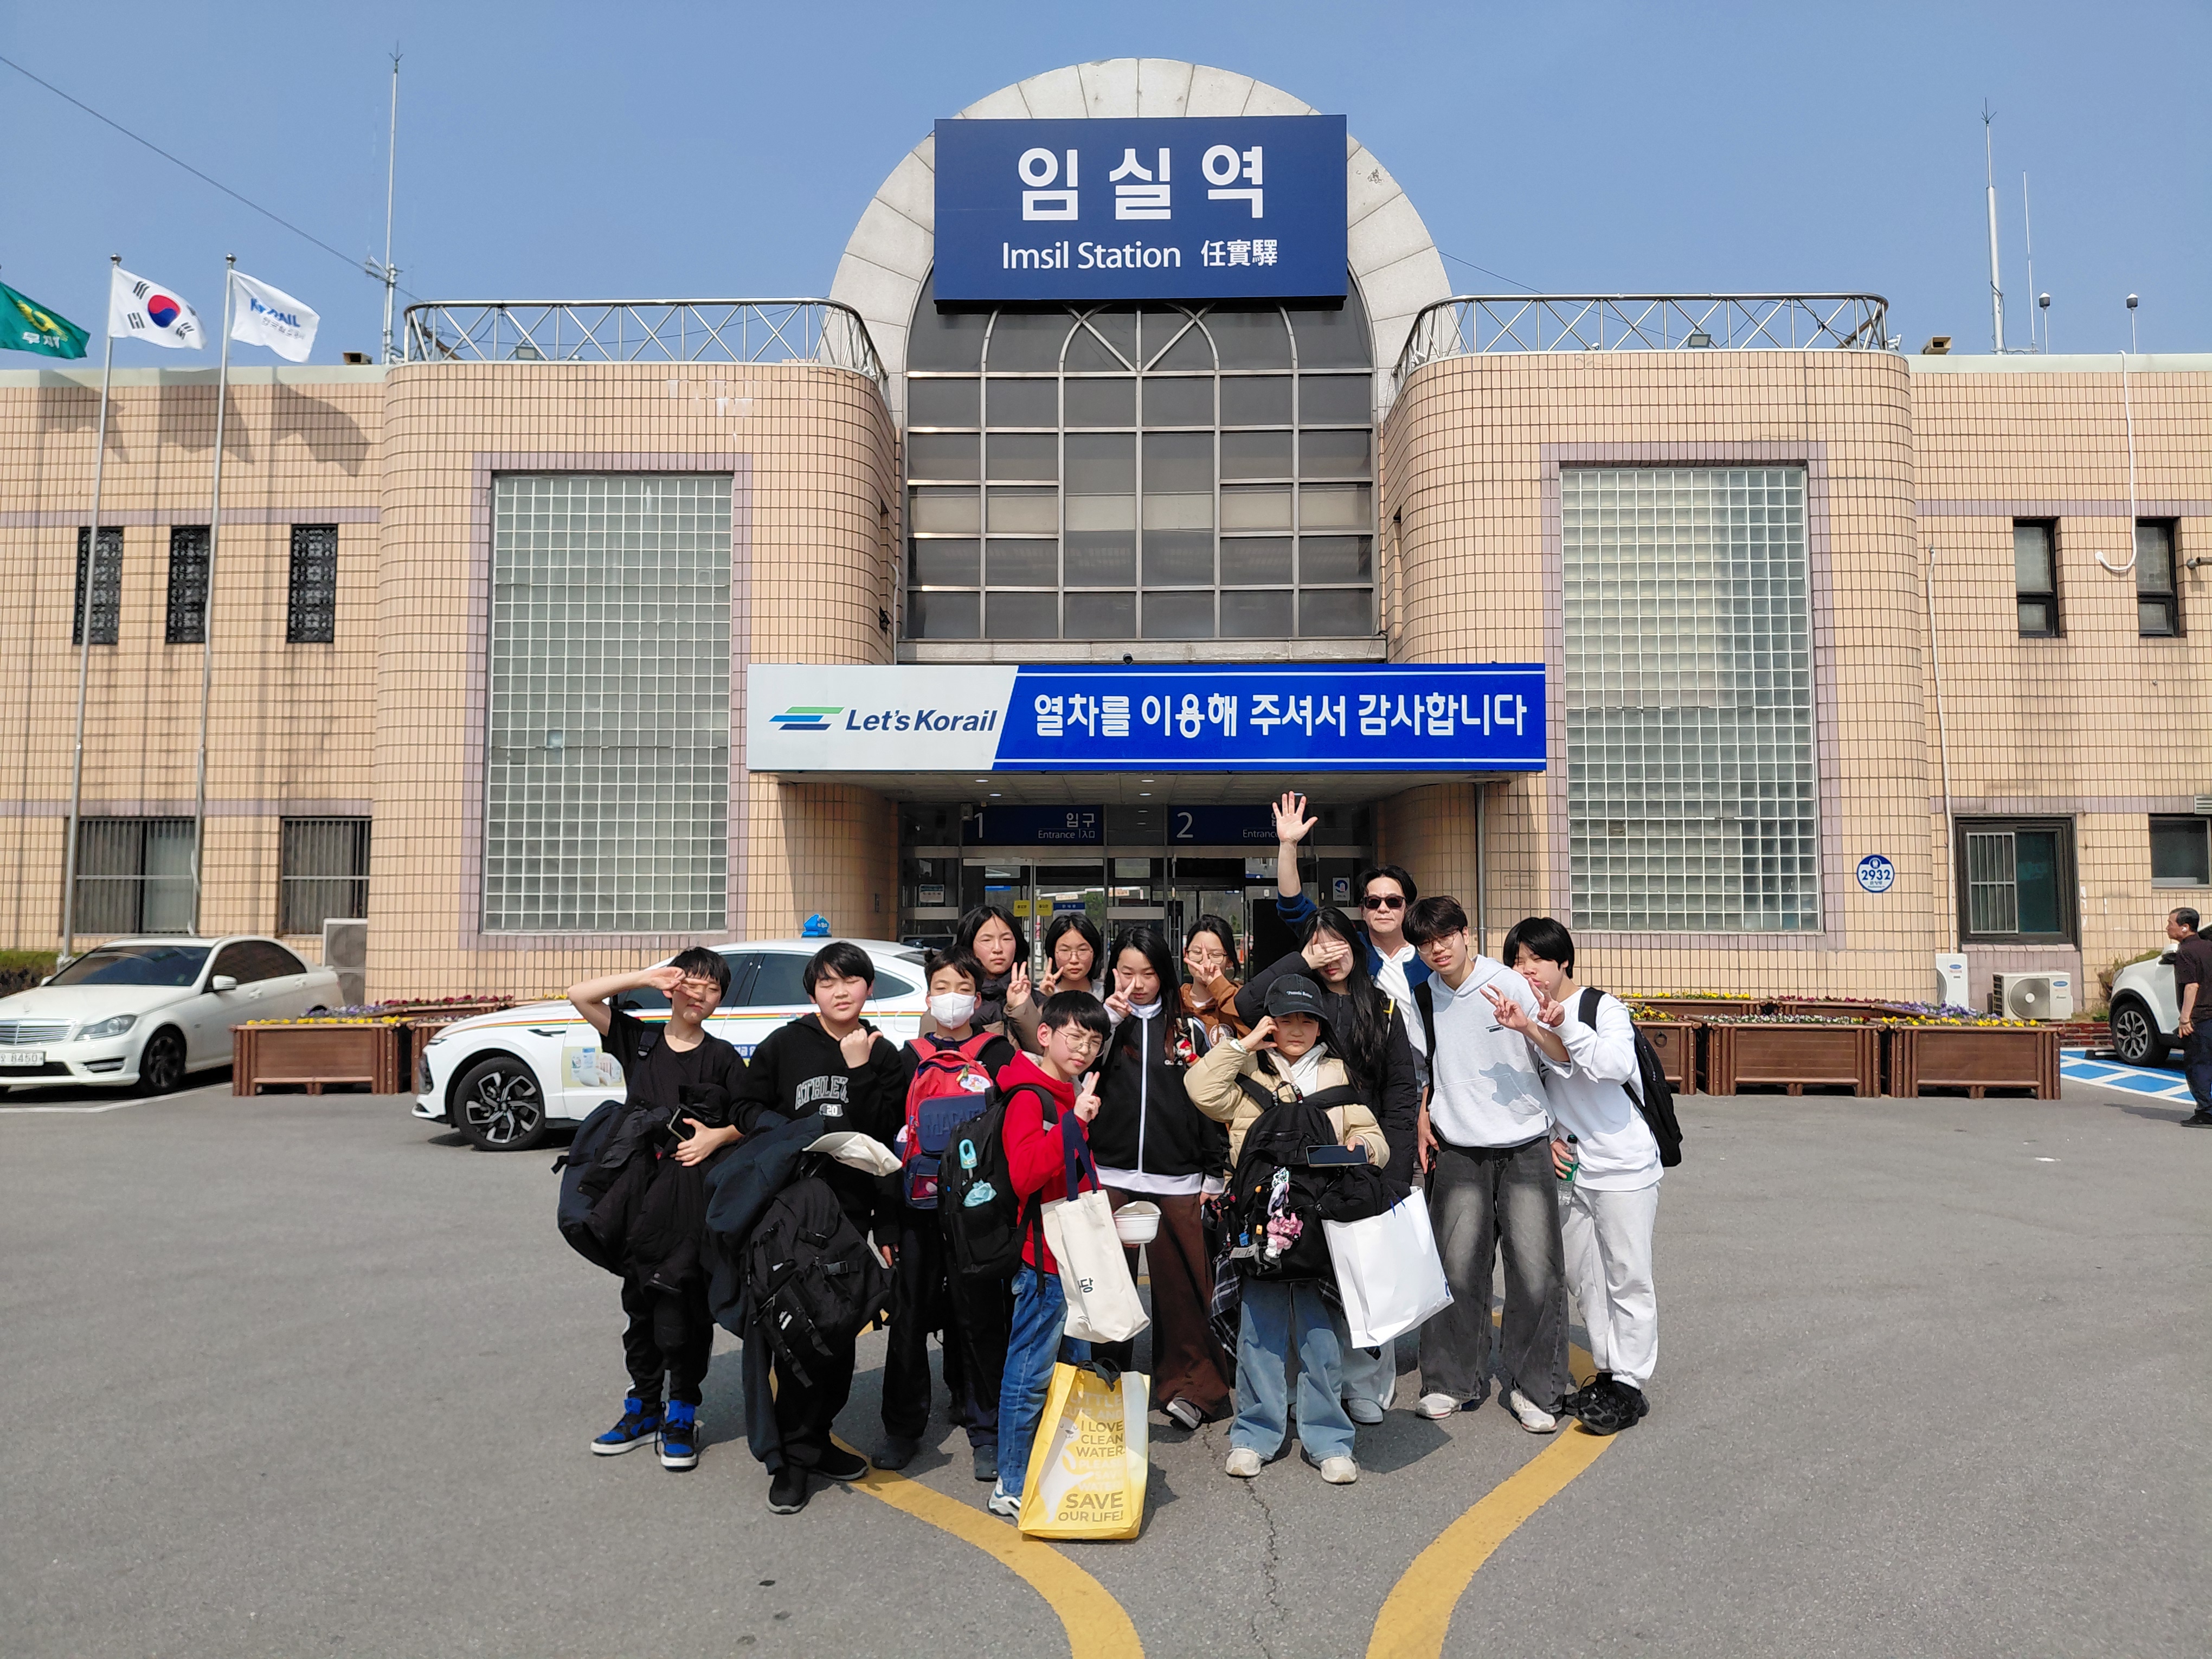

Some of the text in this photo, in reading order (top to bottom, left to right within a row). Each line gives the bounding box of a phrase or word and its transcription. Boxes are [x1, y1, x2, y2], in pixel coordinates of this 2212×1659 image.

[1017, 144, 1264, 221] 임실역
[1002, 239, 1278, 269] Imsil Station 任實驛
[845, 709, 998, 732] Let's Korail
[1034, 692, 1528, 739] 열차를 이용해 주셔서 감사합니다
[974, 812, 983, 838] 1
[1066, 812, 1095, 828] 입구
[1176, 812, 1194, 838] 2
[1038, 830, 1076, 839] Entrance
[1861, 870, 1891, 880] 2932
[826, 1105, 838, 1116] 20
[1077, 1277, 1094, 1293] 당
[1097, 1409, 1122, 1420] AND
[1081, 1420, 1123, 1432] I LOVE
[1081, 1433, 1123, 1445] CLEAN
[1079, 1458, 1123, 1469] PLEASE
[1065, 1490, 1123, 1509] SAVE
[1058, 1510, 1123, 1522] OUR LIFE!
